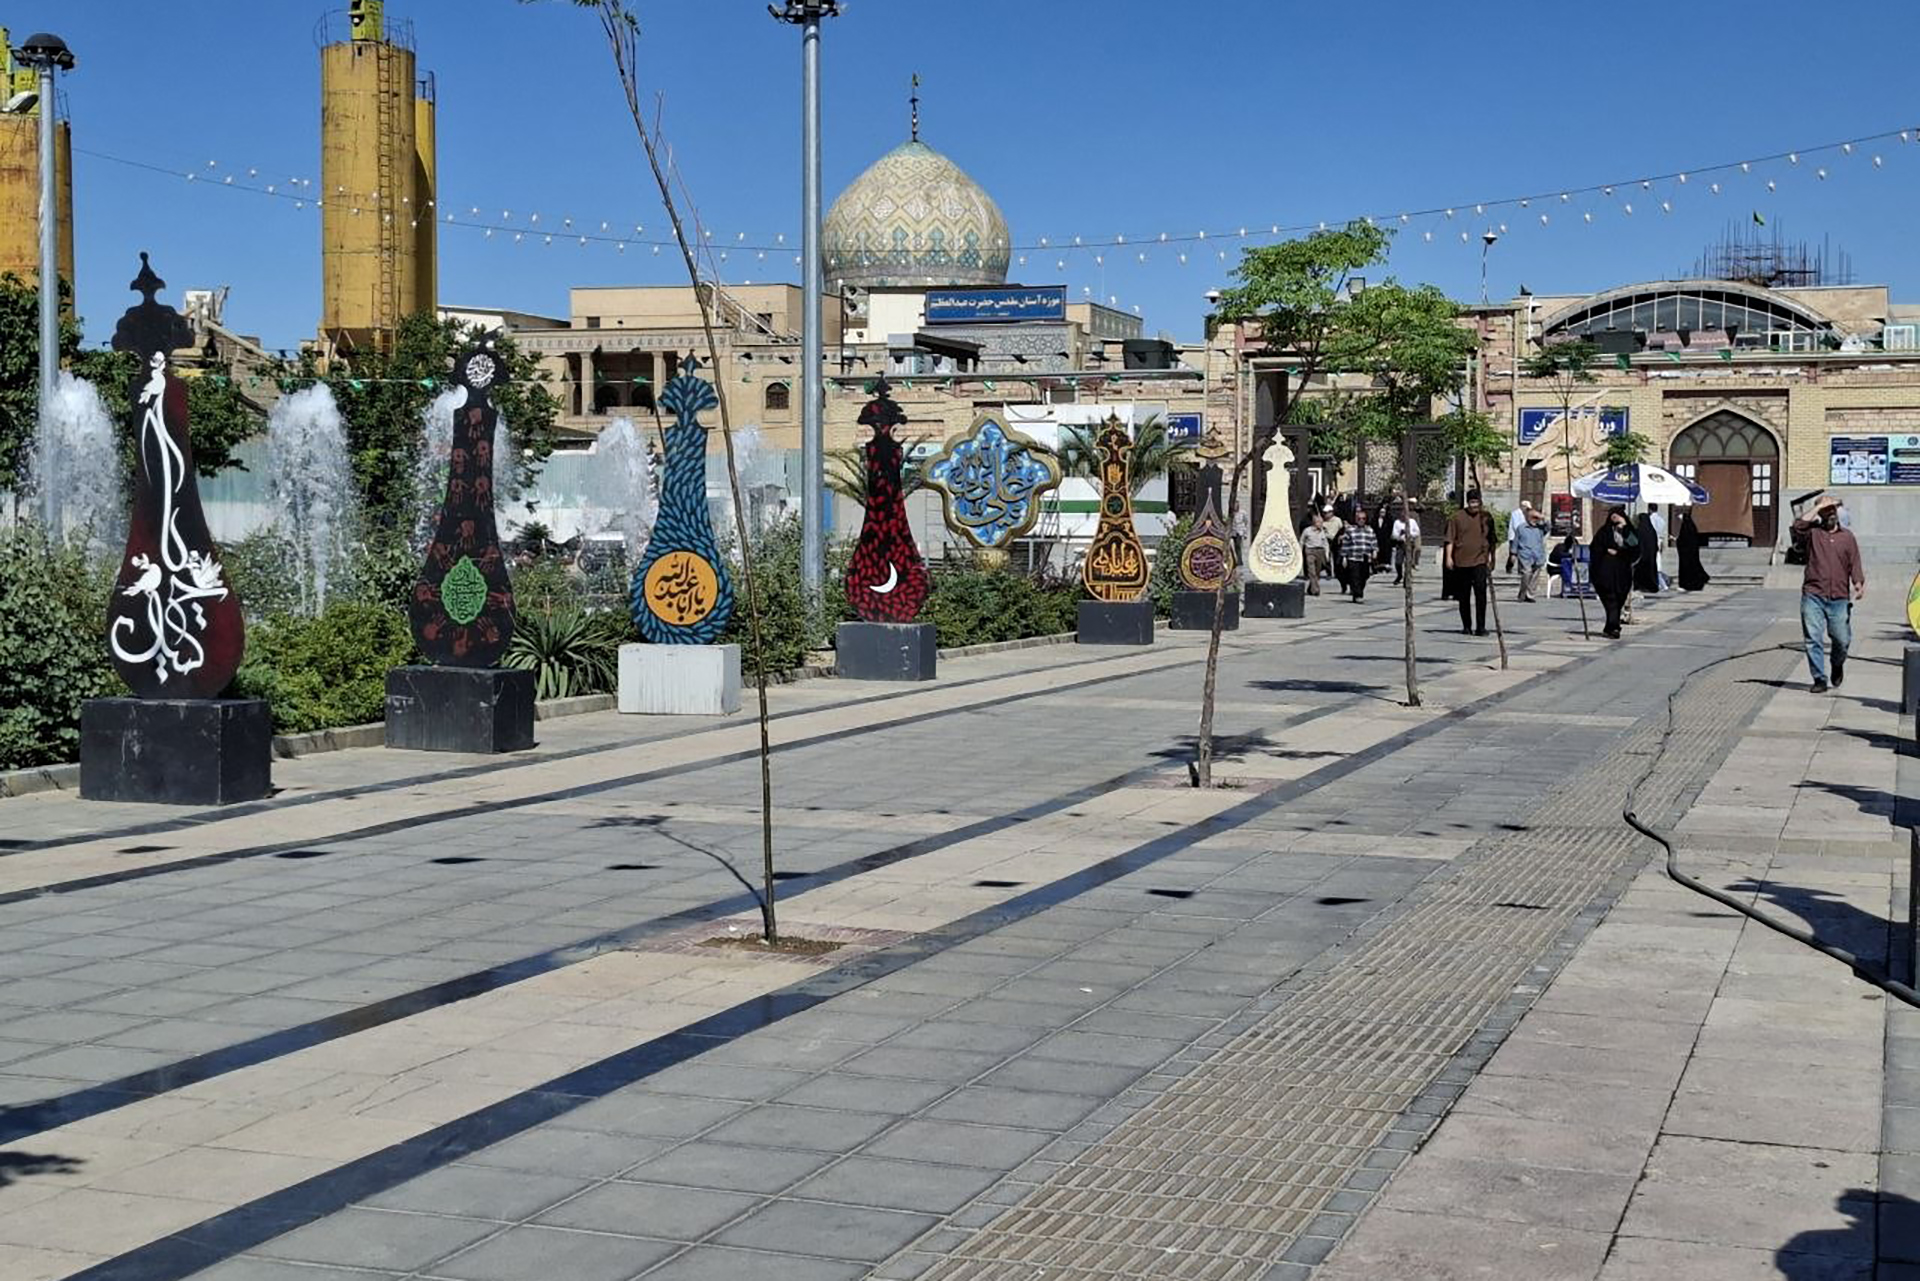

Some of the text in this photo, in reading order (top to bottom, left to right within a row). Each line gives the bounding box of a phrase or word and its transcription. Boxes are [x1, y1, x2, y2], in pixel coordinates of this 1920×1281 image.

[968, 297, 994, 310] حضرت
[994, 296, 1018, 309] مقدس
[1019, 294, 1041, 308] آستان
[1042, 296, 1060, 308] موزه
